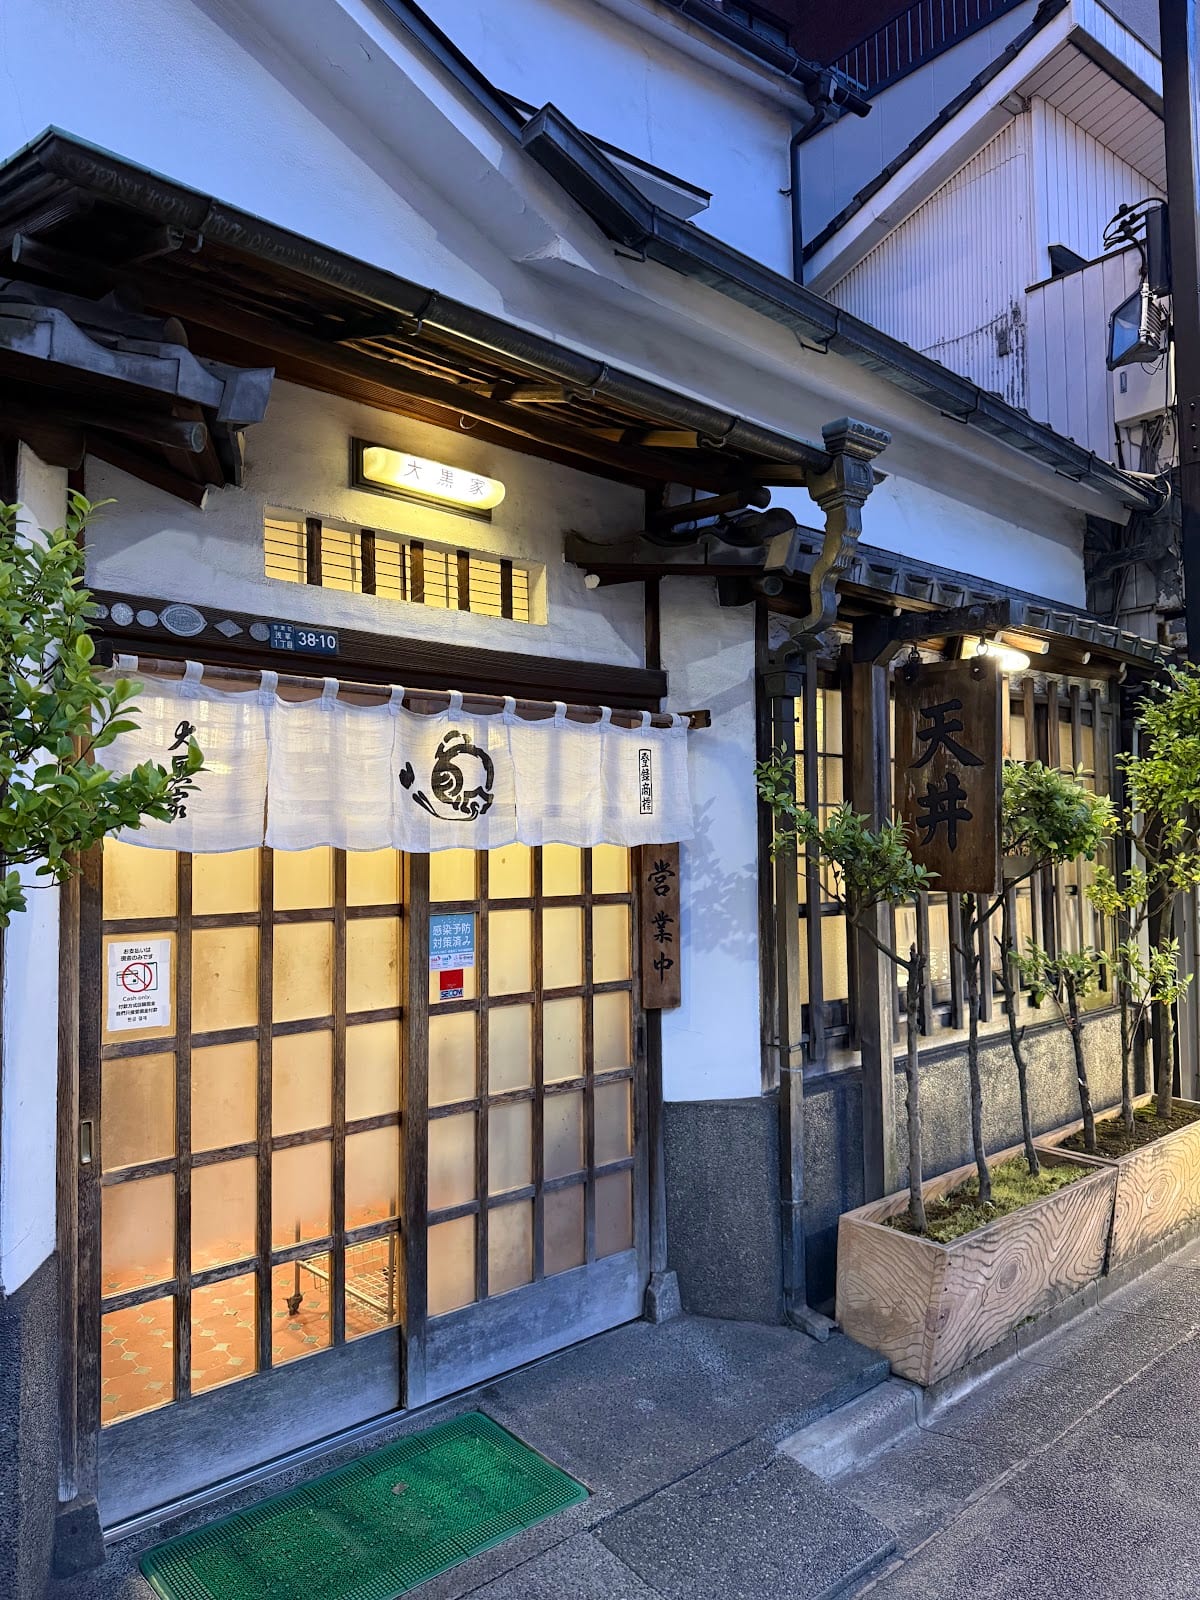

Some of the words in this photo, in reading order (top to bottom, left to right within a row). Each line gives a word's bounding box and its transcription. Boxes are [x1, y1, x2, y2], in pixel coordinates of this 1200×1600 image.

[403, 460, 486, 496] 大黒家
[298, 631, 336, 649] 38-10
[647, 858, 676, 985] 営業中
[432, 922, 471, 936] 感染予防
[432, 935, 471, 949] 対策済み
[122, 994, 137, 1002] Cash
[441, 988, 463, 998] SECOM
